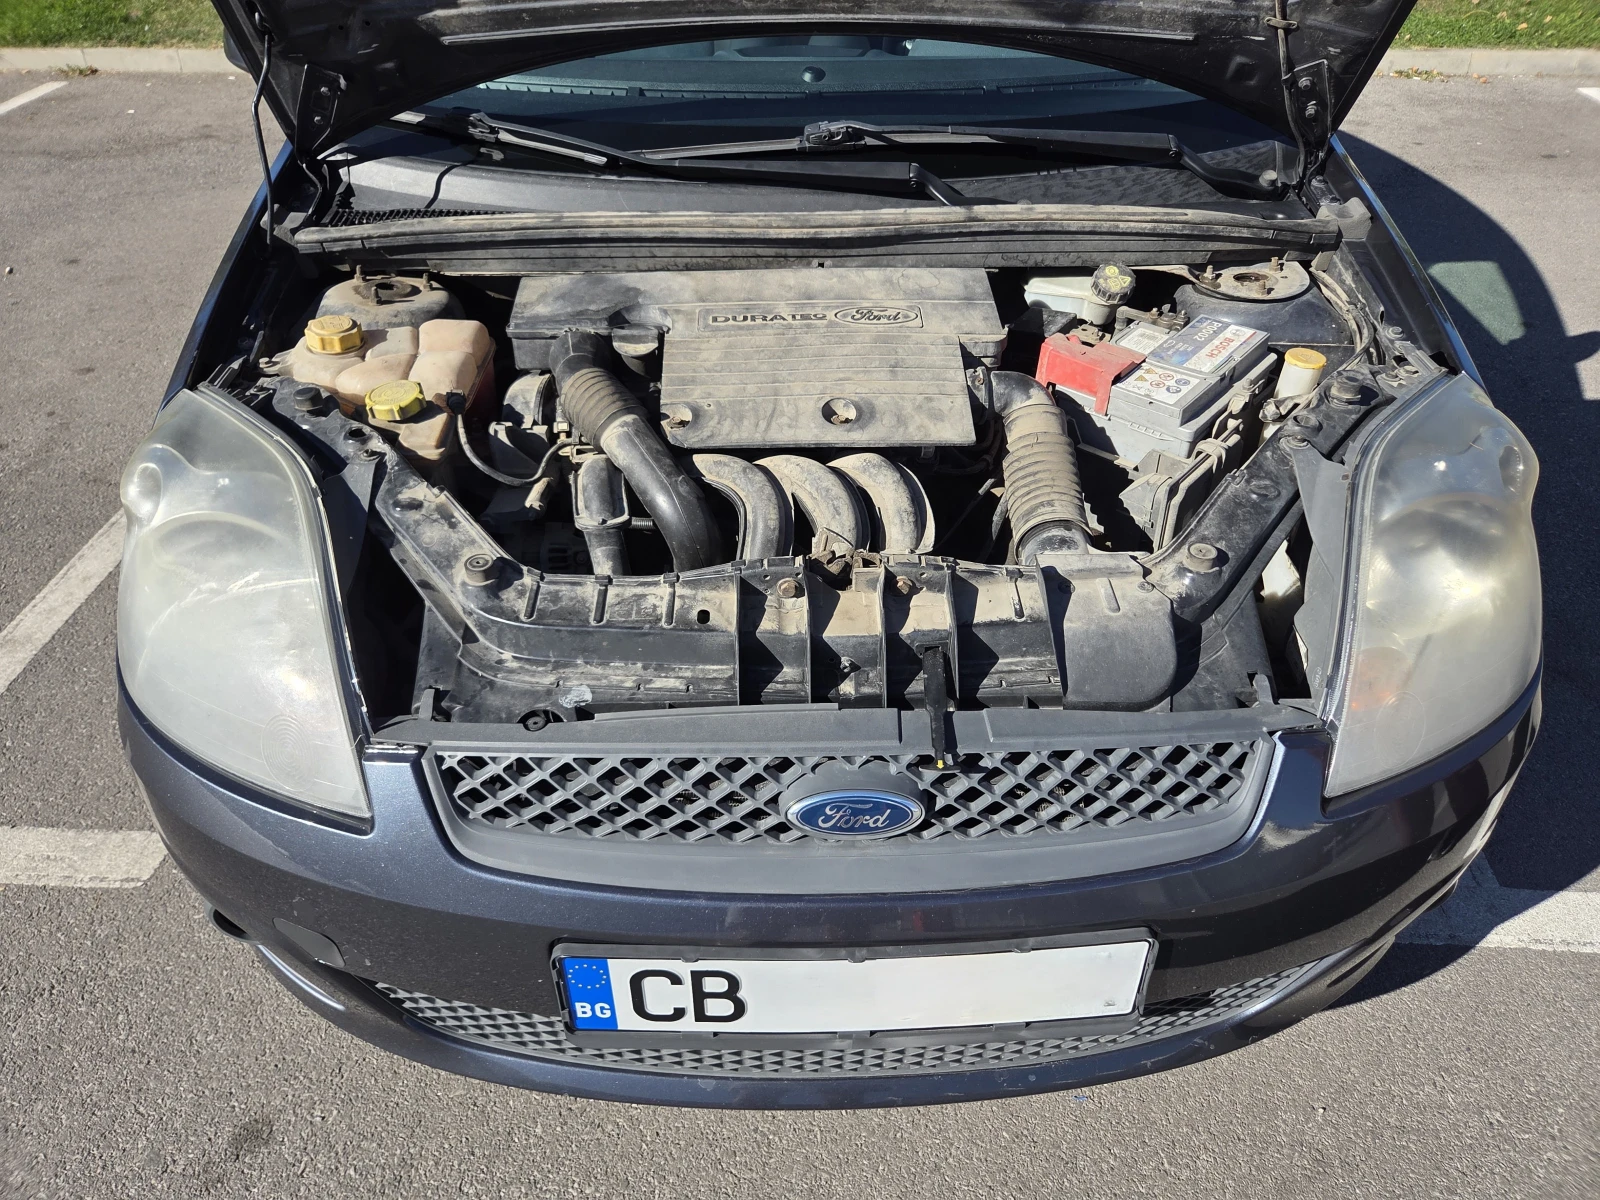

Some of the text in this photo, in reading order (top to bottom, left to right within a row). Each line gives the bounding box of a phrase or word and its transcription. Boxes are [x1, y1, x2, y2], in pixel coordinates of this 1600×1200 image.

[711, 308, 901, 324] DURATEC Ford
[1205, 337, 1235, 358] BOSCH
[818, 802, 892, 828] Ford
[629, 969, 748, 1023] CB
[575, 1002, 612, 1018] BG
